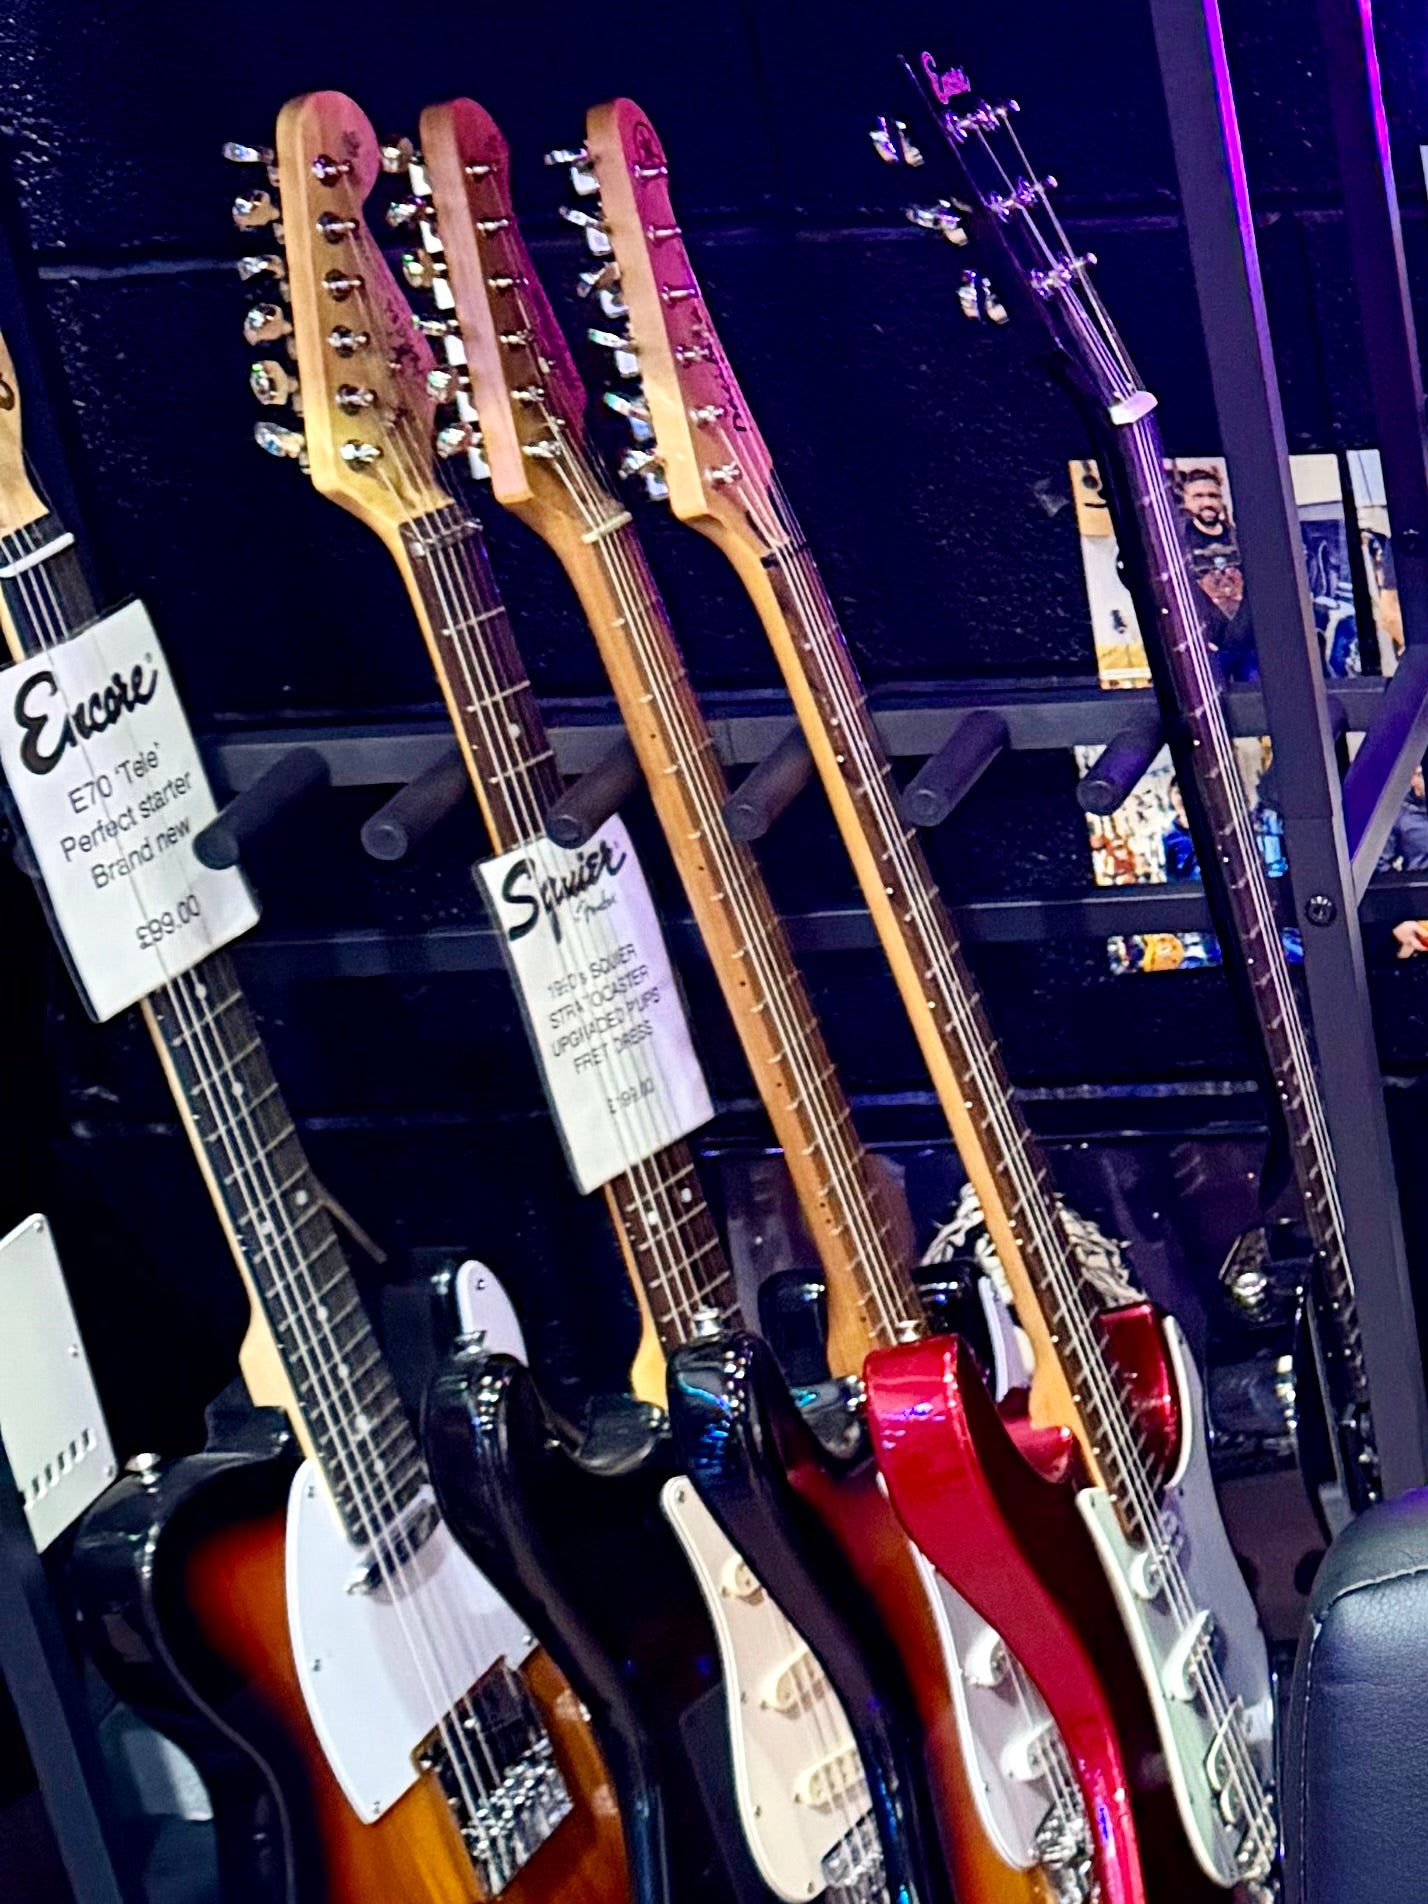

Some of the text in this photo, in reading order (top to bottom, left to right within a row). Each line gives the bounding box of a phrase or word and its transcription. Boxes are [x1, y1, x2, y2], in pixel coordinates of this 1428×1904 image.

[13, 664, 159, 776] Encore
[59, 771, 193, 863] Perfect starter
[67, 774, 113, 814] E70
[90, 816, 192, 890] Brand new
[502, 839, 628, 945] Squier
[135, 894, 201, 951] £99.00
